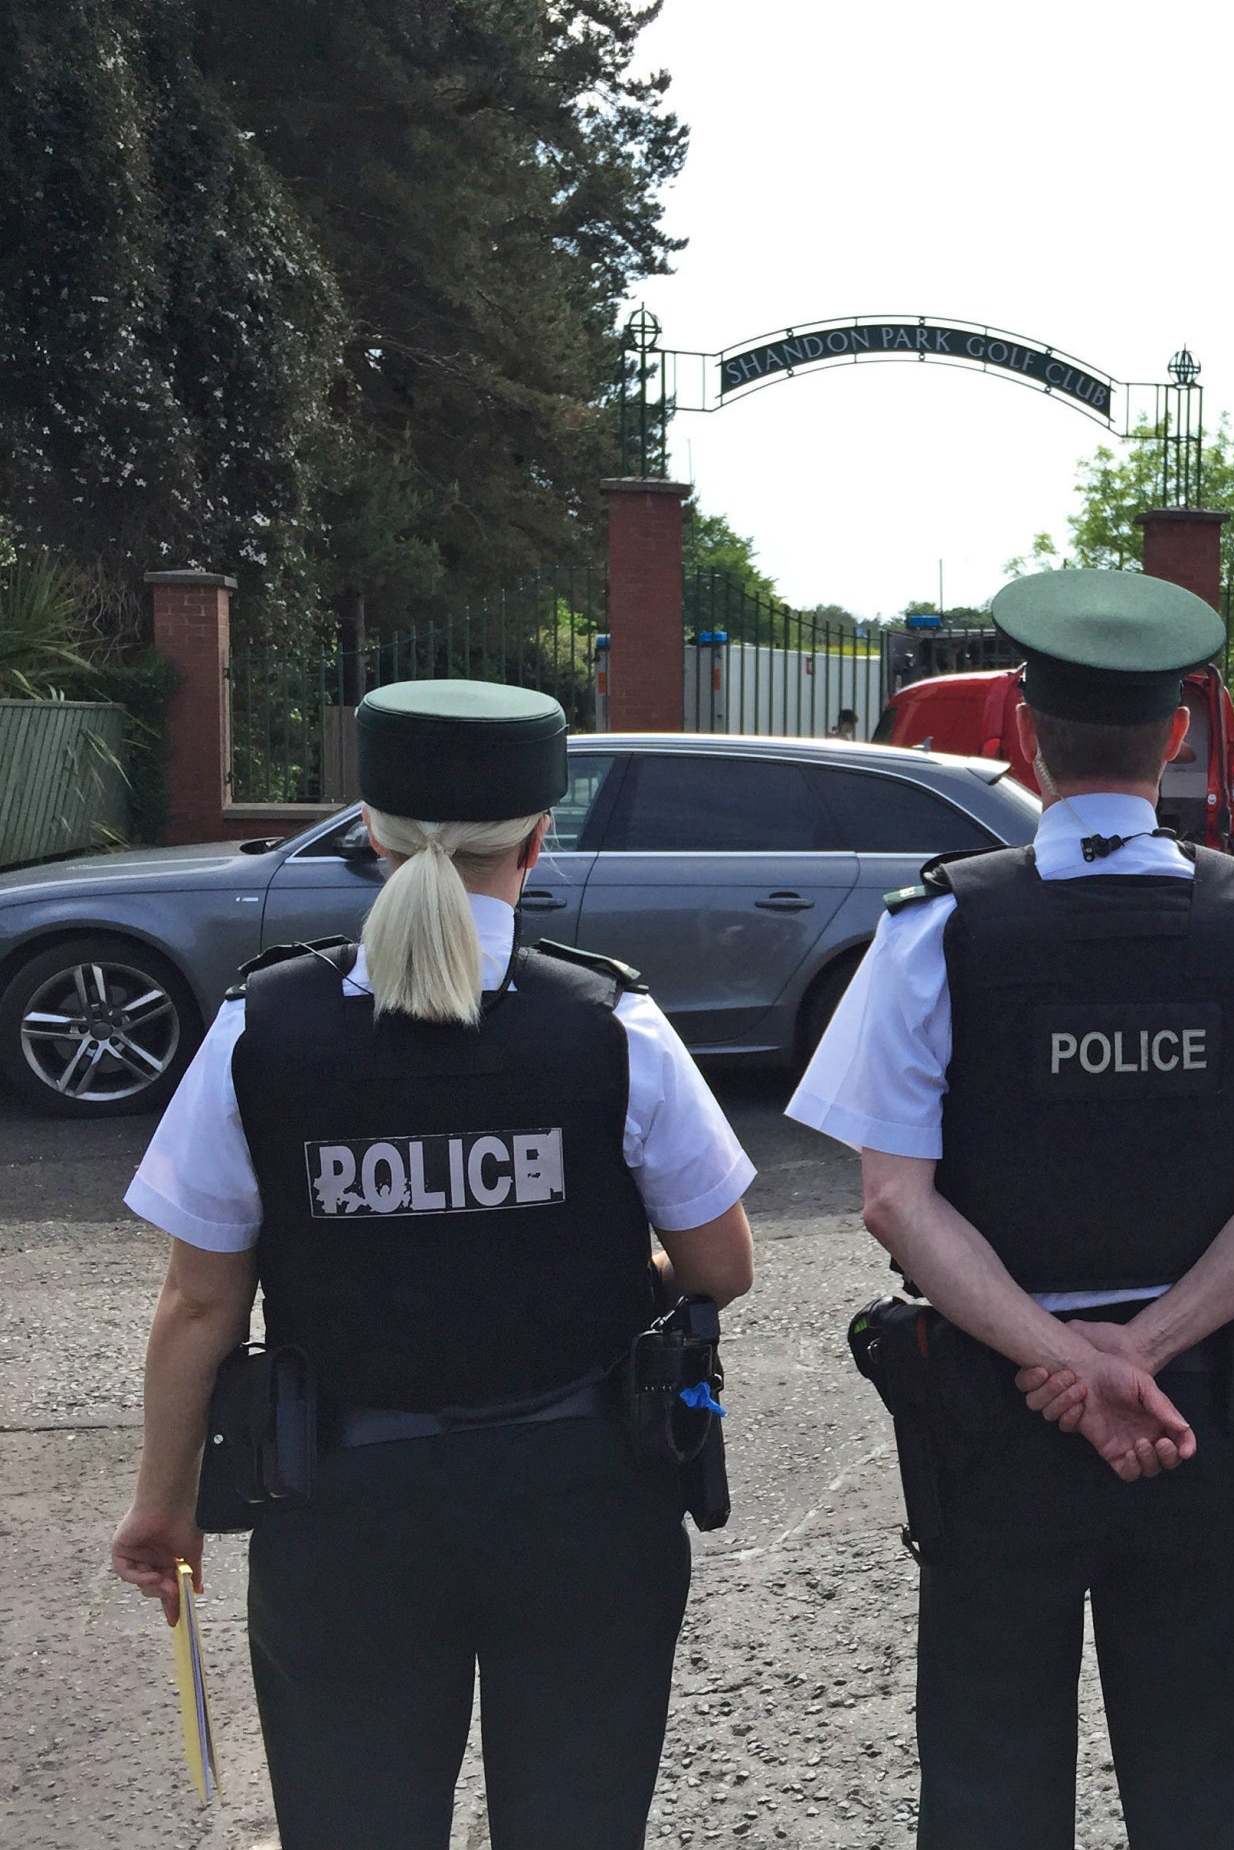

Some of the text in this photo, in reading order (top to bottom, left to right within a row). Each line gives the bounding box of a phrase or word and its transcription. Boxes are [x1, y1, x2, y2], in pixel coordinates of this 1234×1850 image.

[726, 327, 1109, 406] SHANDON PARK GOLF CLUB
[1051, 1029, 1207, 1074] POLICE
